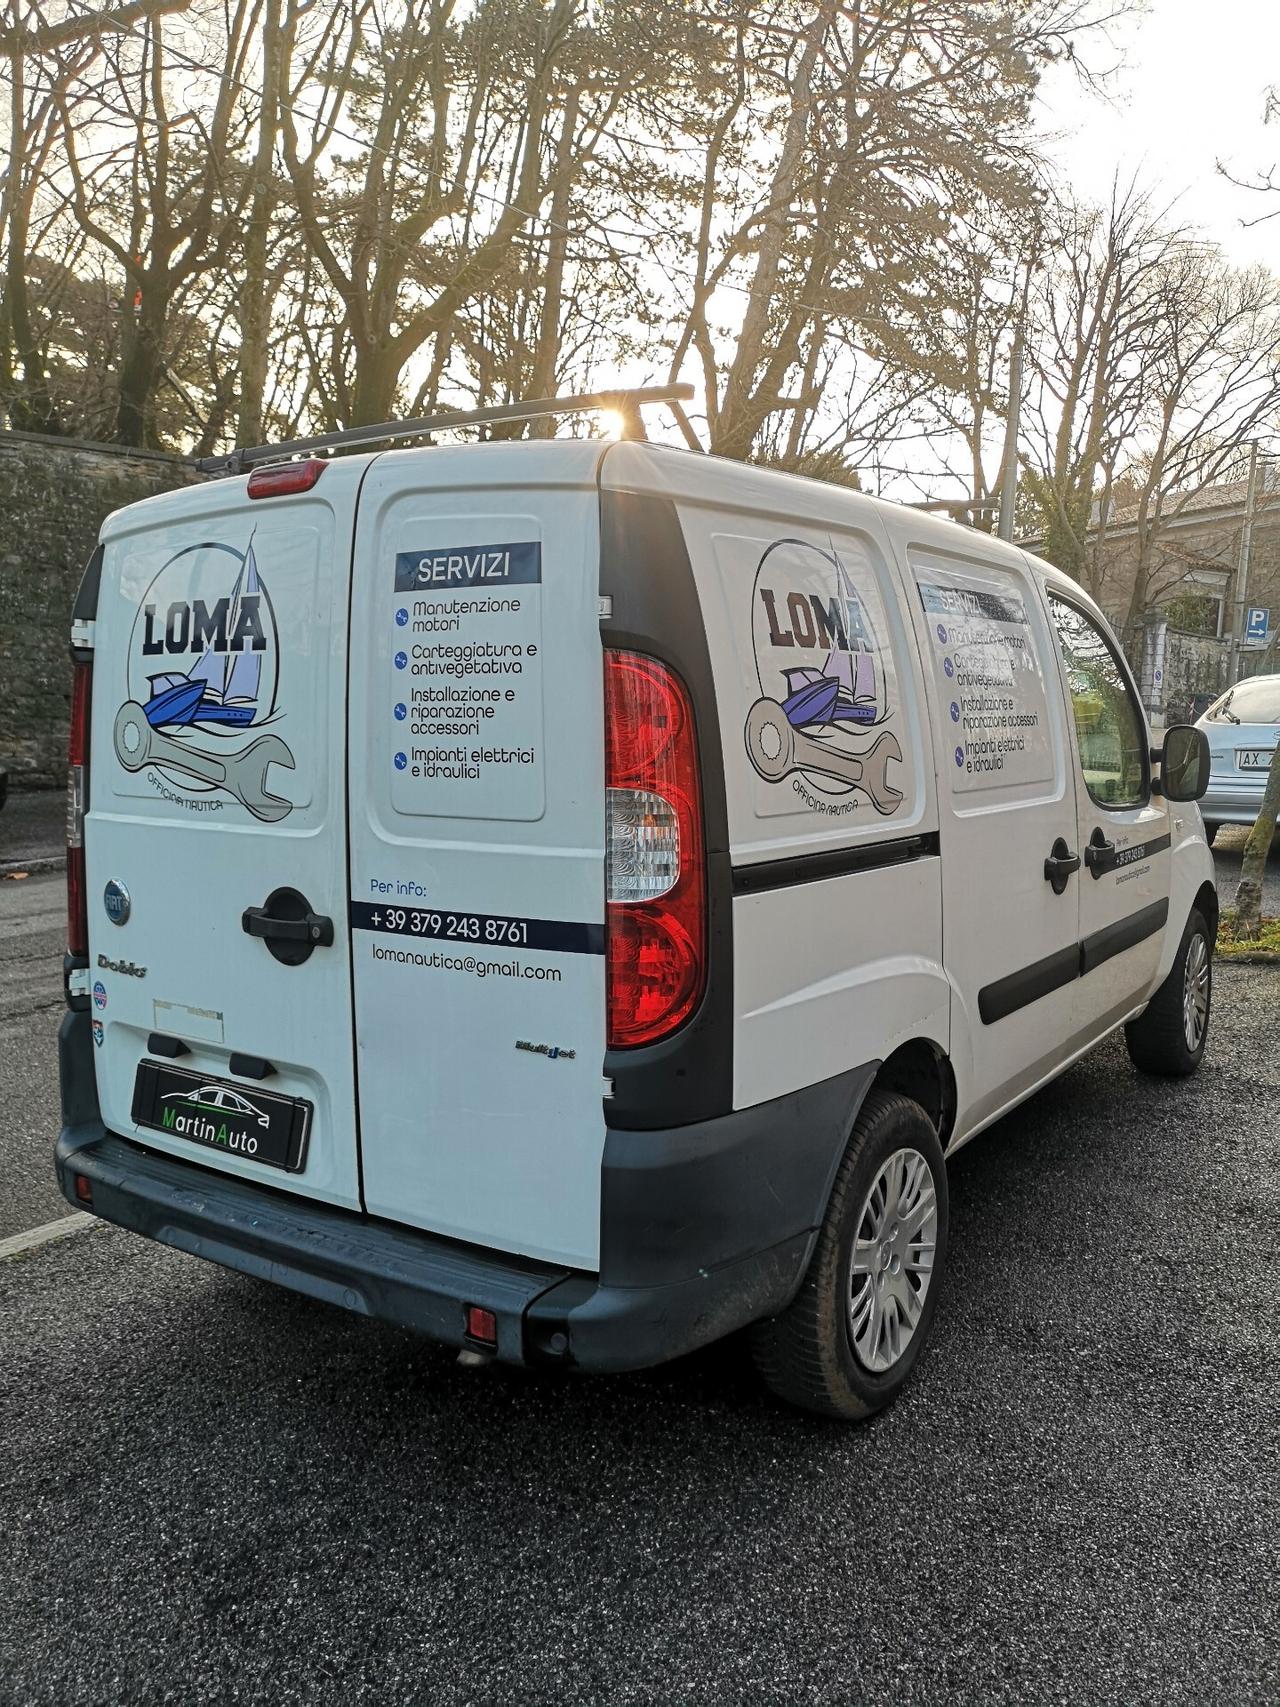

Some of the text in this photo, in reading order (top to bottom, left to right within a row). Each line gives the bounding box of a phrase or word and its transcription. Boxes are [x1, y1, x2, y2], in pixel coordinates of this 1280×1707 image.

[418, 552, 510, 582] SERVIZI
[413, 597, 521, 616] Manutenzione
[940, 590, 981, 614] SERVIZI
[143, 596, 267, 656] LOMA
[412, 615, 460, 632] motori
[760, 588, 875, 653] LOMA
[1251, 610, 1265, 626] P
[412, 642, 537, 662] Carteggiatura e
[411, 657, 523, 679] antivegetativa
[411, 686, 516, 702] Installazione e
[960, 695, 1014, 711] Installazione e
[411, 703, 495, 722] riparazione
[411, 720, 479, 735] accessori
[962, 712, 1038, 733] riparazione accessori
[411, 746, 534, 765] Impianti elettrici
[964, 735, 1025, 759] Impianti elettrici
[966, 754, 1004, 773] e idraulici
[1243, 752, 1260, 765] AX
[411, 763, 480, 778] e idraulici
[371, 879, 427, 897] Per info:
[105, 893, 123, 911] FIAT
[385, 909, 406, 930] 39
[410, 912, 442, 934] 379
[446, 916, 480, 939] 243
[484, 920, 528, 943] 8761
[373, 944, 562, 981] lomanautica@gmail.com
[162, 1106, 258, 1154] MartinAuto
